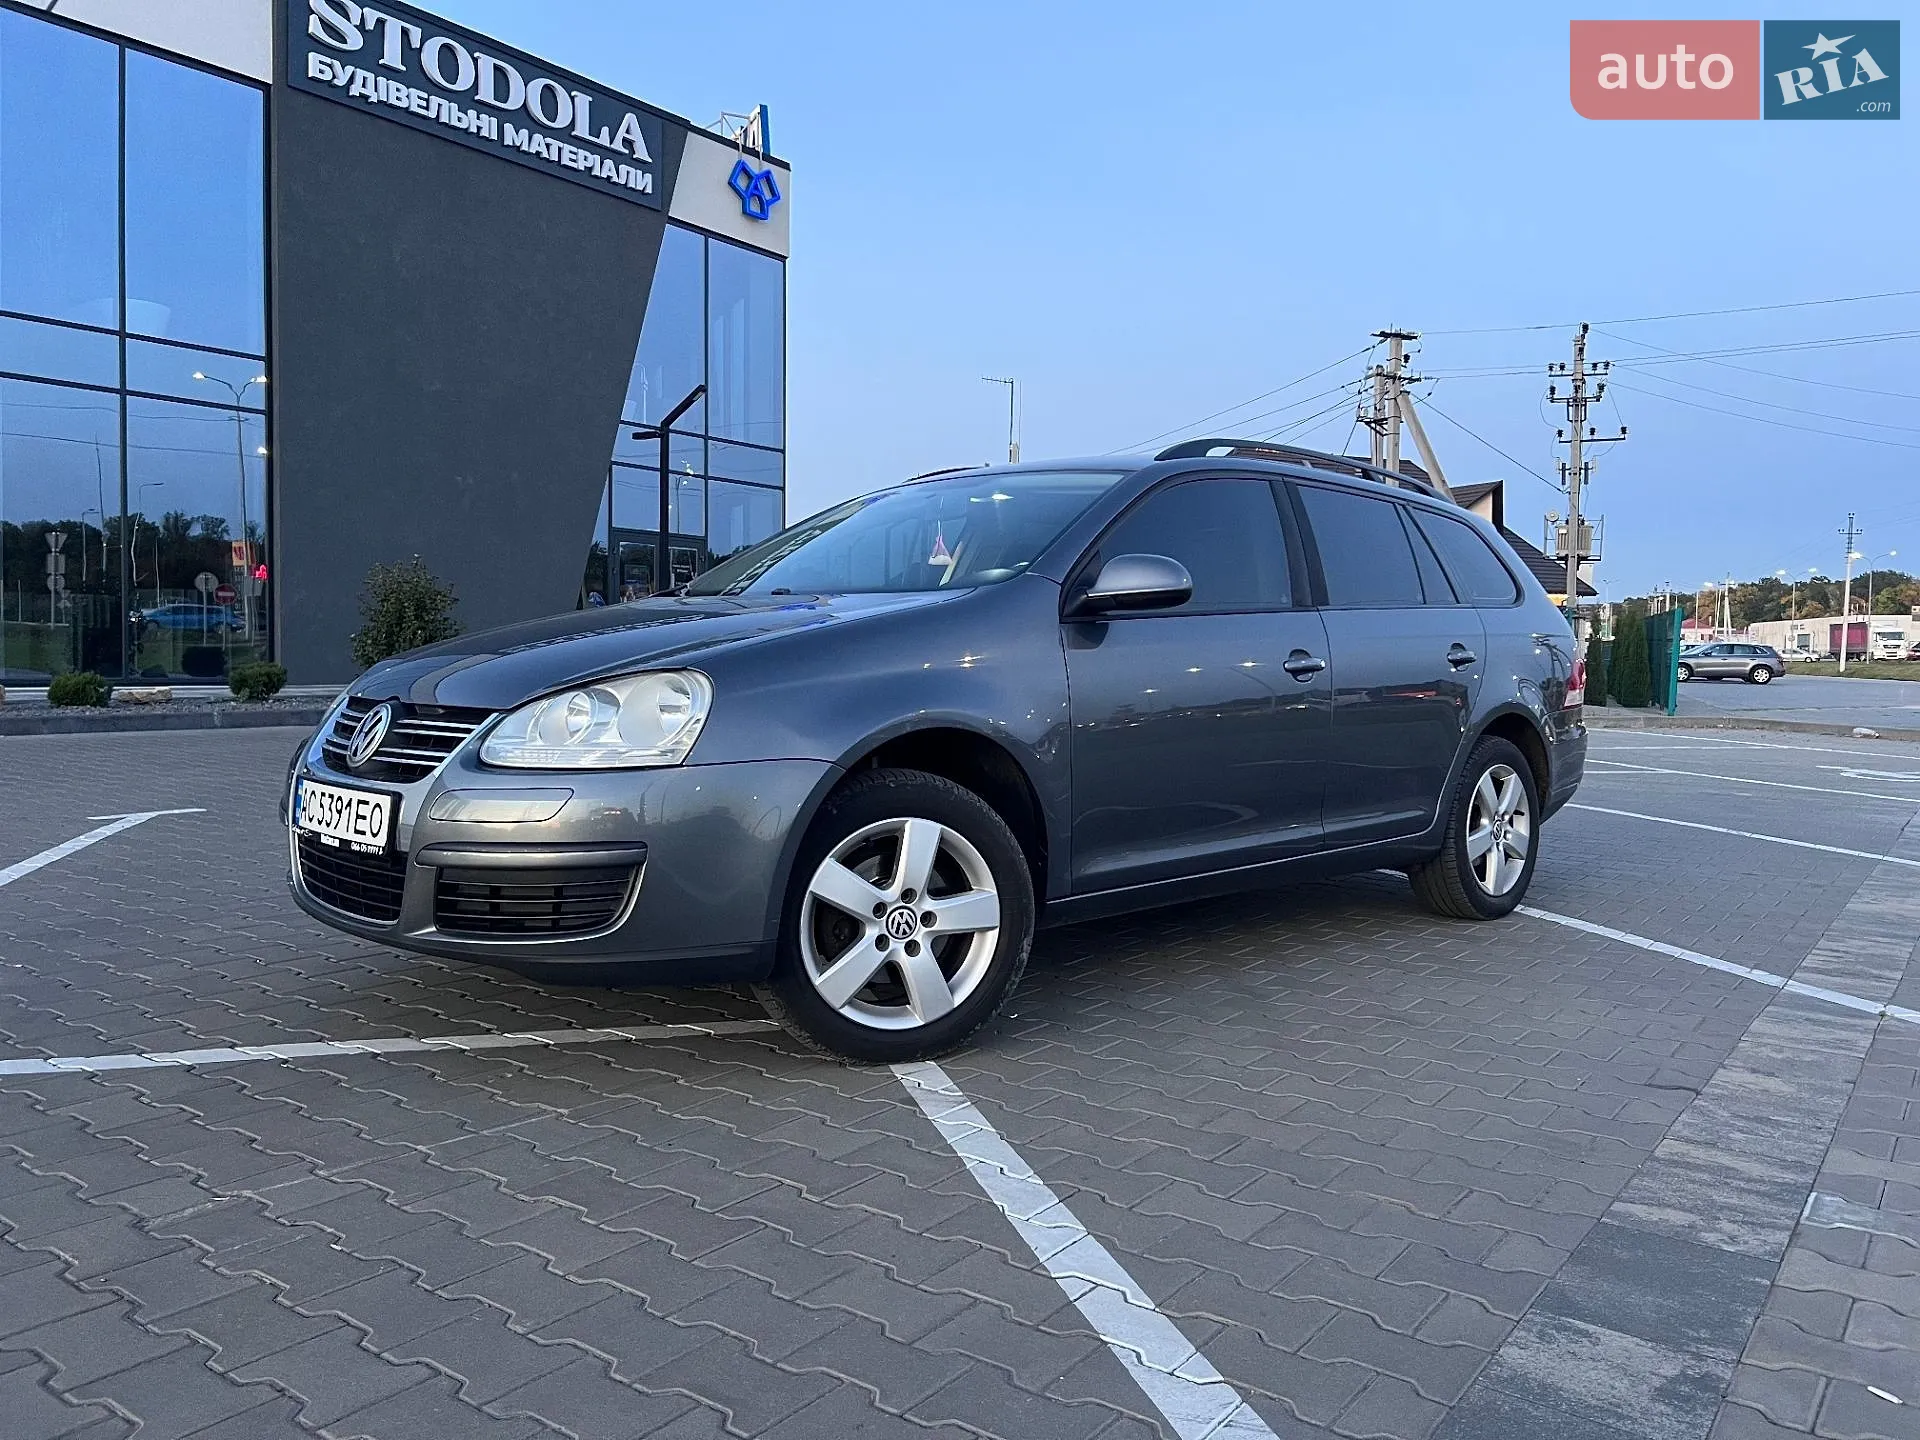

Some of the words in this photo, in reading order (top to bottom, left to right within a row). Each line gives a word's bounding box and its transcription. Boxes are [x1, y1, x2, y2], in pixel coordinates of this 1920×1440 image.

[308, 0, 652, 163] STODOLA
[308, 52, 498, 140] БУДІВЕЛЬНІ
[503, 122, 652, 194] МАТЕРІАЛИ
